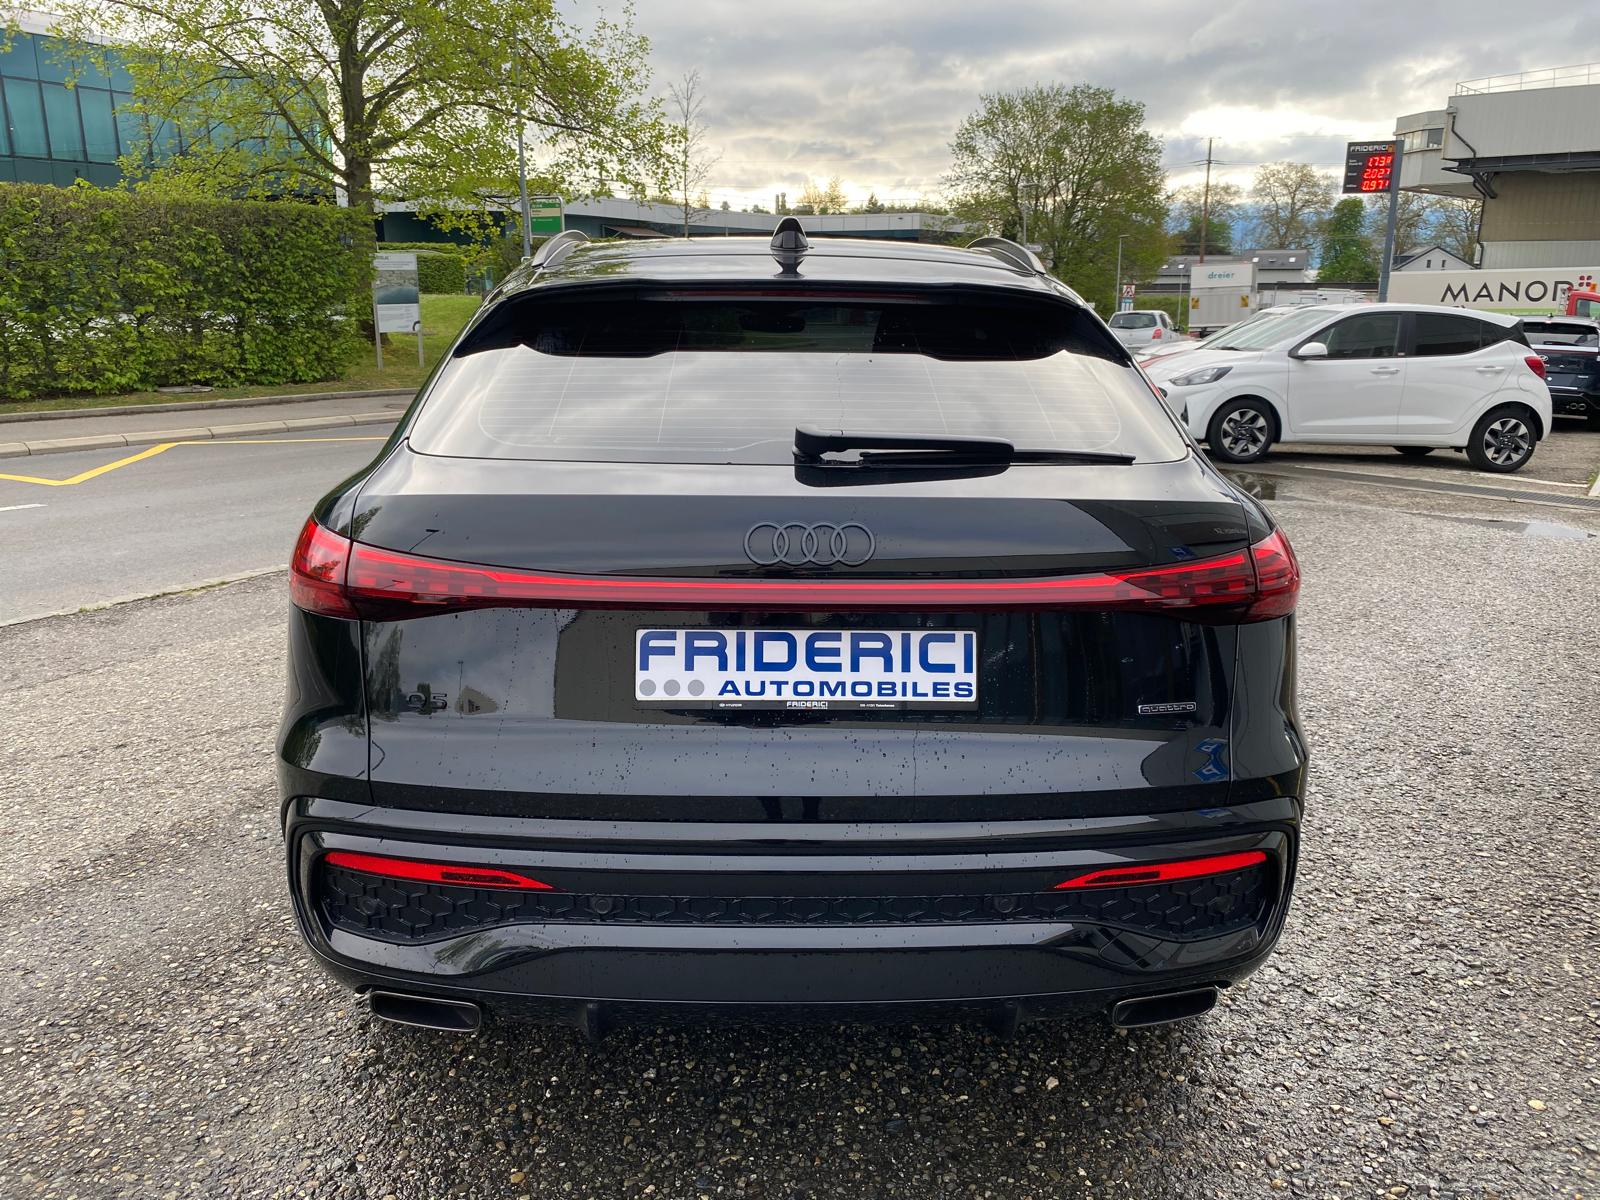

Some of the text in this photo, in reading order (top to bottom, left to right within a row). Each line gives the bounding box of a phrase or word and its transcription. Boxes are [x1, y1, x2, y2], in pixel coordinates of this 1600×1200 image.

[1350, 144, 1388, 152] FRIDERICI
[1207, 271, 1235, 280] dreier
[639, 630, 974, 673] FRIDERICI
[718, 679, 974, 698] AUTOMOBILES
[1141, 704, 1194, 713] quattro
